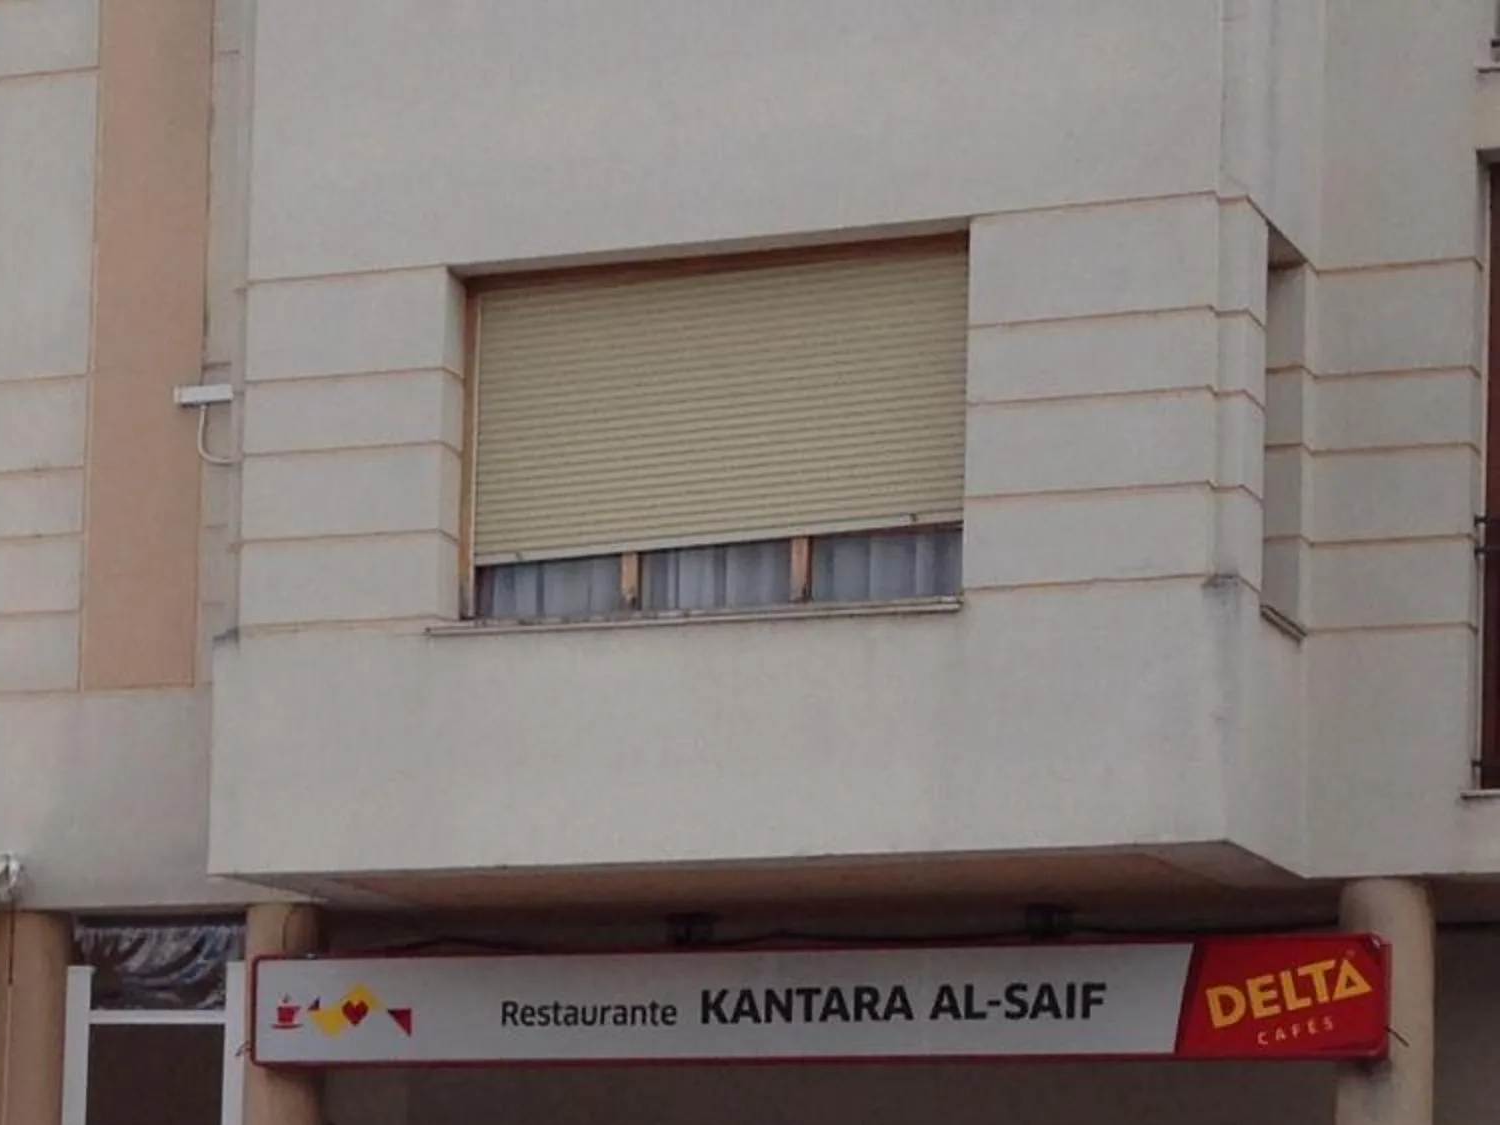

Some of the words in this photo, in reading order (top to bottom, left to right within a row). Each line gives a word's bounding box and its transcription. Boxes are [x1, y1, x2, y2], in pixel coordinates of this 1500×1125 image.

[501, 1000, 678, 1027] Restaurante
[700, 986, 915, 1024] KANTARA
[929, 982, 1107, 1021] AL-SAIF
[1205, 958, 1373, 1030] DELTA
